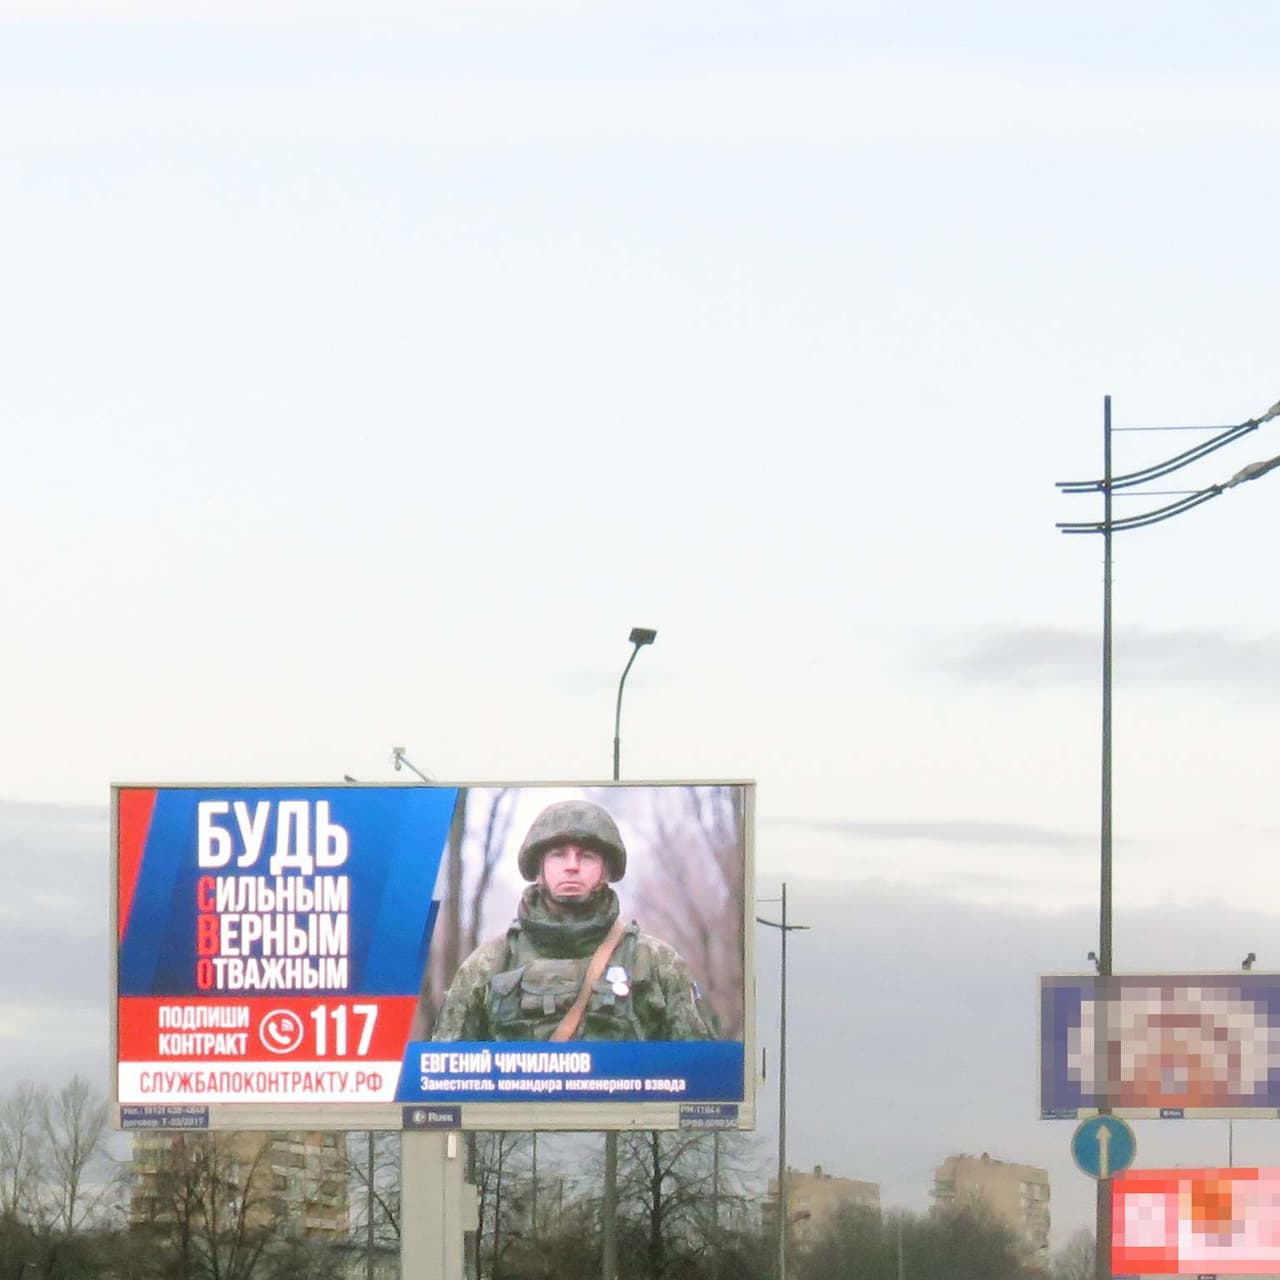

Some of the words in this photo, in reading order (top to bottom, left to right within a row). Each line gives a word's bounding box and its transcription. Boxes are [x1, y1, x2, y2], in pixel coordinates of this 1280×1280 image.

[197, 800, 349, 875] БУДЬ
[197, 876, 348, 912] СИЛЬНЫМ
[197, 914, 348, 956] ВЕРНЫМ
[196, 958, 348, 989] ОТВАЖНЫМ
[158, 1006, 250, 1029] ПОДПИШИ
[310, 1004, 378, 1056] 117
[158, 1033, 248, 1056] КОНТРАКТ
[420, 1049, 491, 1073] ЕВГЕНИЙ
[495, 1053, 591, 1073] ЧИЧИЛАНОВ
[139, 1071, 382, 1093] СЛУЖБАПОКОНТРАКТУ.РФ
[420, 1076, 495, 1091] Заместитель
[498, 1078, 562, 1092] командира
[566, 1078, 641, 1092] инженерного
[645, 1079, 686, 1092] взвода
